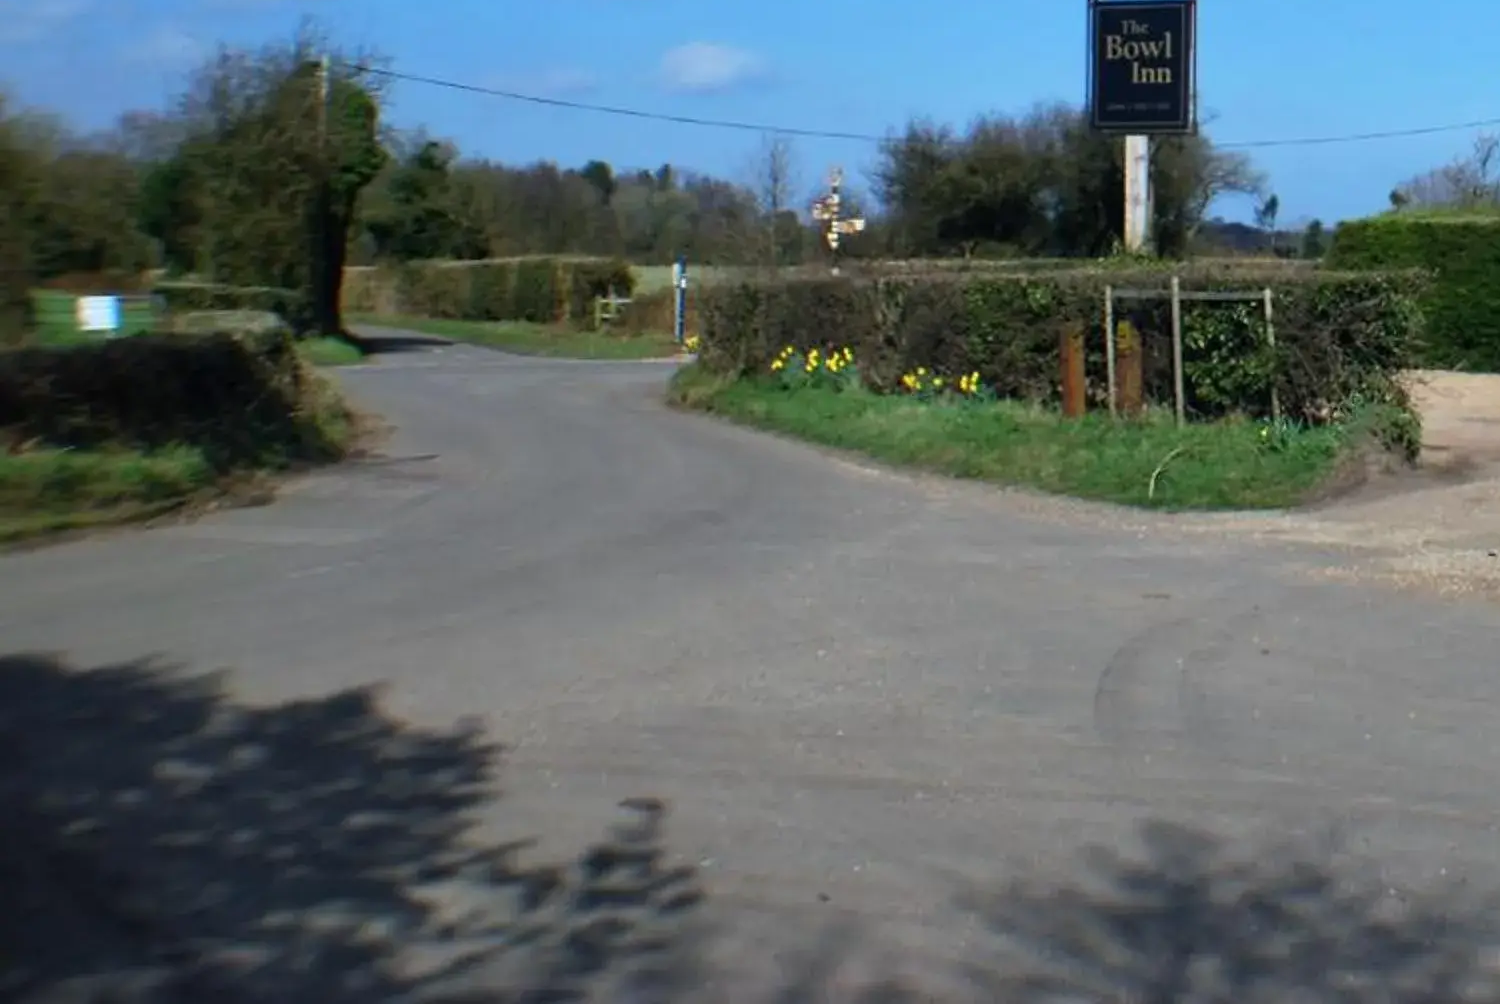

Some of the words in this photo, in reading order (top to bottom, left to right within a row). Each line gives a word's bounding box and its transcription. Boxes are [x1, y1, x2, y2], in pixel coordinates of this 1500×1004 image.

[1121, 20, 1149, 34] The
[1106, 31, 1172, 59] Bowl
[1132, 61, 1172, 84] Inn
